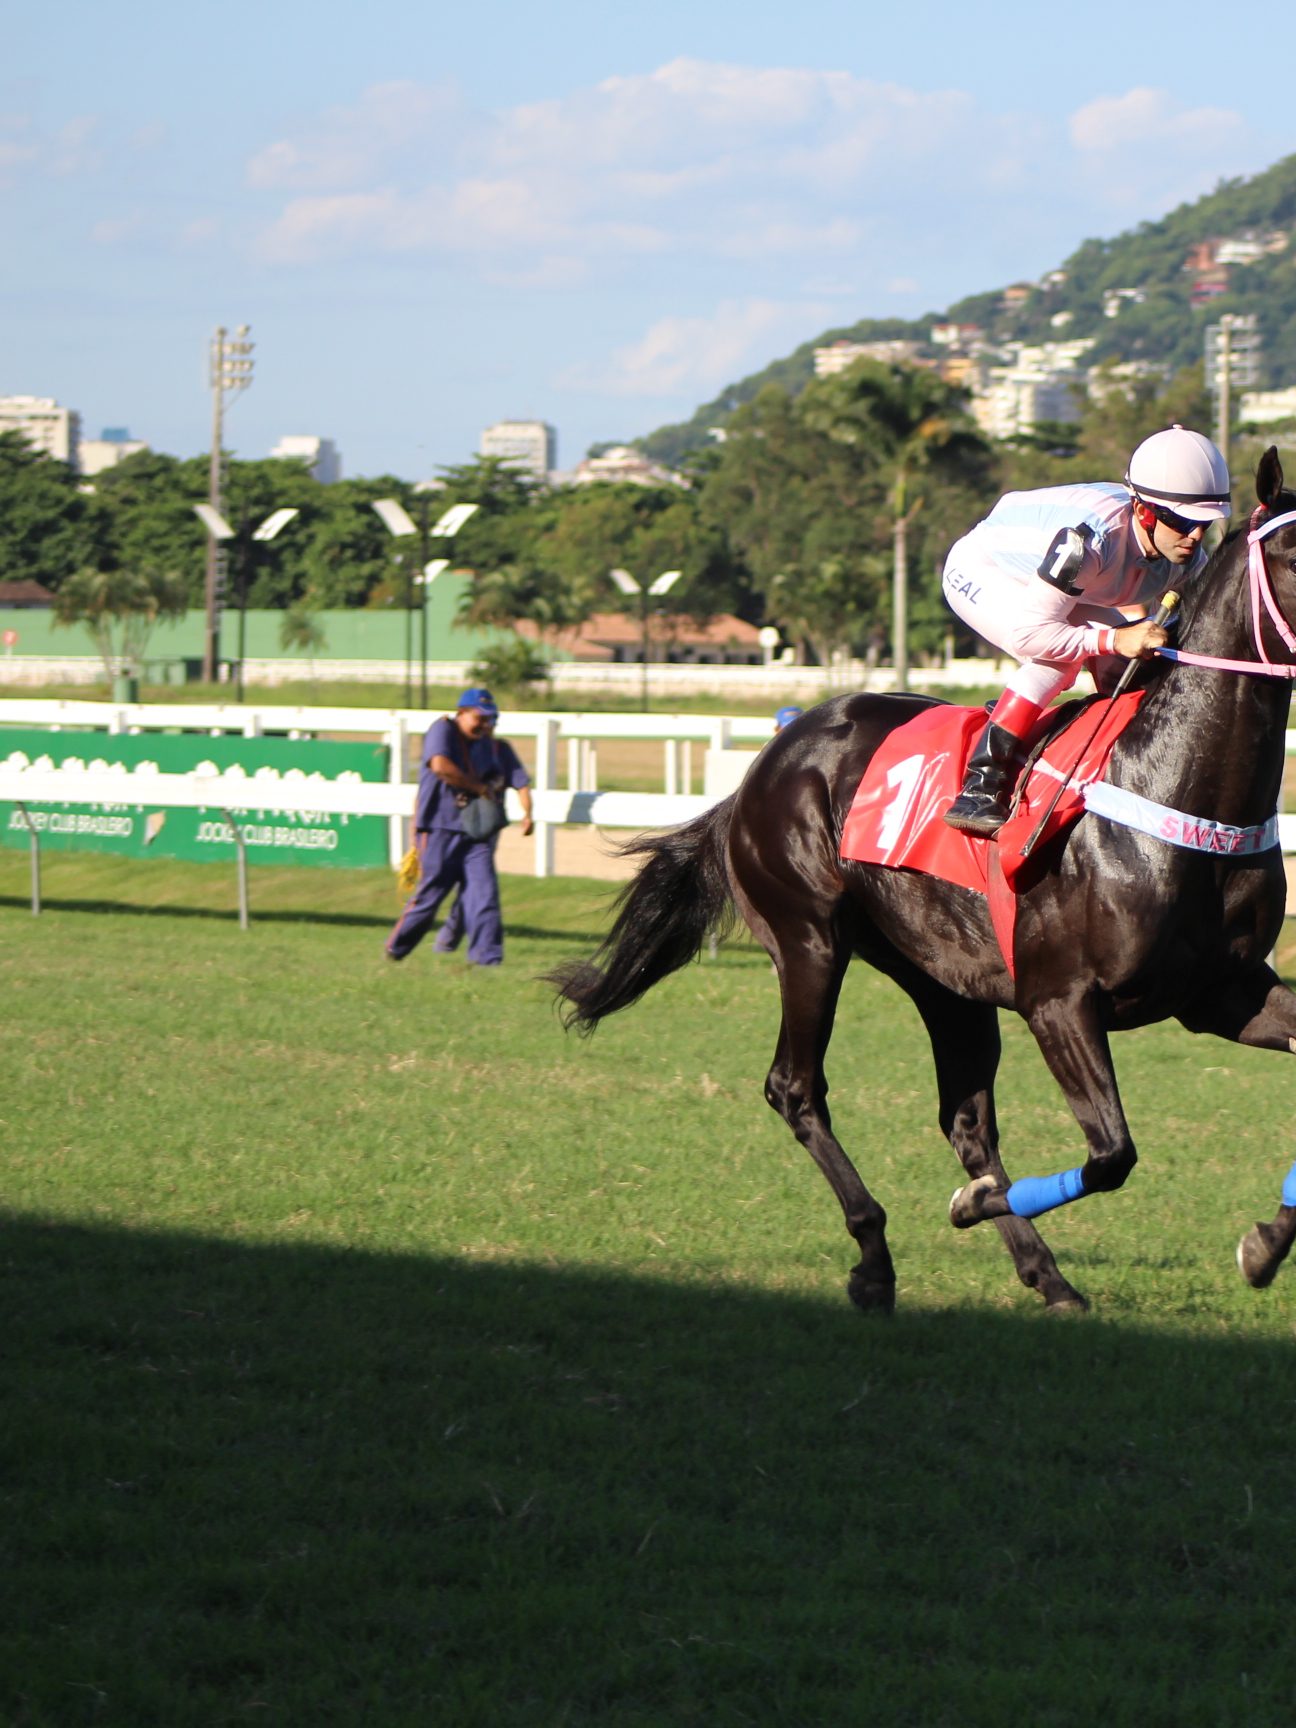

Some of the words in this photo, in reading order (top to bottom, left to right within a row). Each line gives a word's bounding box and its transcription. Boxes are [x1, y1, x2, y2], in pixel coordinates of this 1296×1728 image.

[1049, 529, 1080, 579] 1
[946, 567, 982, 605] LEAL
[876, 754, 926, 851] 1
[243, 823, 273, 847] CLUB
[1159, 815, 1266, 853] SWEET
